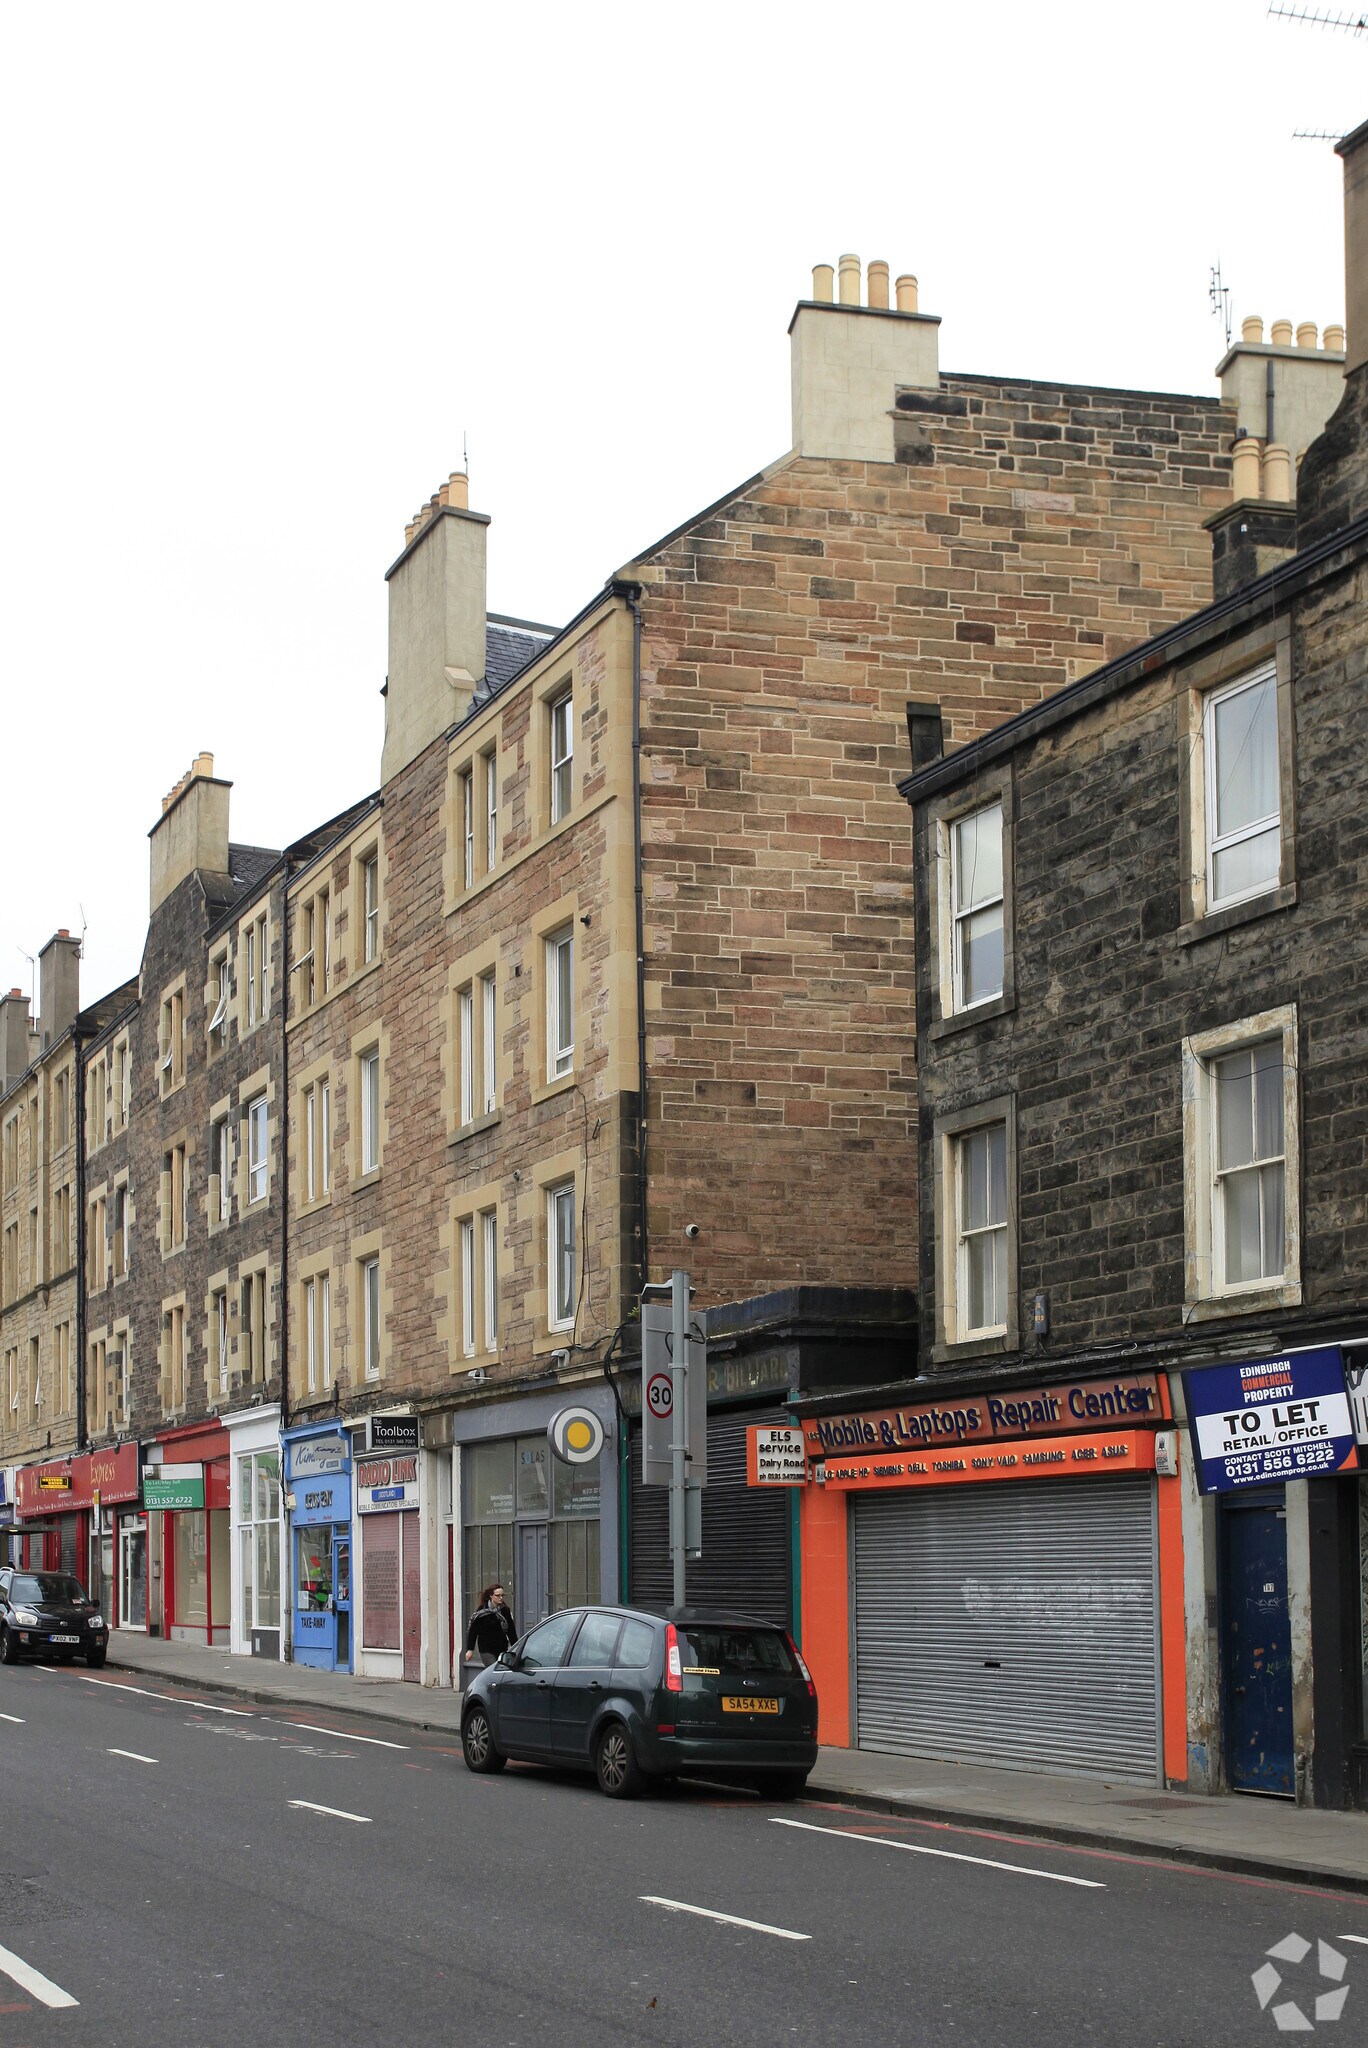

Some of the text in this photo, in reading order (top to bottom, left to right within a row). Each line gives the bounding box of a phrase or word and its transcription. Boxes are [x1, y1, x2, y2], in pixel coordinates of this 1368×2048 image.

[1240, 1360, 1291, 1378] EDINBURGH
[1241, 1372, 1293, 1391] COMMERCIAL
[650, 1386, 672, 1405] 30
[1244, 1385, 1294, 1403] PROPERTY
[817, 1384, 1157, 1448] Mobile & Laptops Repair Center
[1223, 1401, 1321, 1436] TO LET
[374, 1426, 416, 1437] Toolbox
[770, 1431, 791, 1442] ELS
[1223, 1424, 1329, 1451] RETAIL/OFFICE
[759, 1443, 801, 1454] service
[931, 1459, 966, 1471] TOSHIBA
[971, 1457, 994, 1468] SONY
[997, 1454, 1018, 1466] VAIO
[1022, 1450, 1065, 1464] SAMSUNG
[1071, 1447, 1097, 1460] ACER
[1101, 1444, 1128, 1457] ASUS
[1224, 1441, 1333, 1466] CONTACT SCOTT MITCHELL
[90, 1458, 116, 1486] Express
[358, 1456, 417, 1488] RADIO LINK
[783, 1459, 806, 1468] Road
[1225, 1449, 1334, 1477] 0131 556 6222
[759, 1474, 767, 1482] ph
[1232, 1462, 1329, 1484] www.edincomprop.co.uk
[176, 1496, 193, 1504] 6722
[729, 1698, 777, 1710] SA54 XXE
